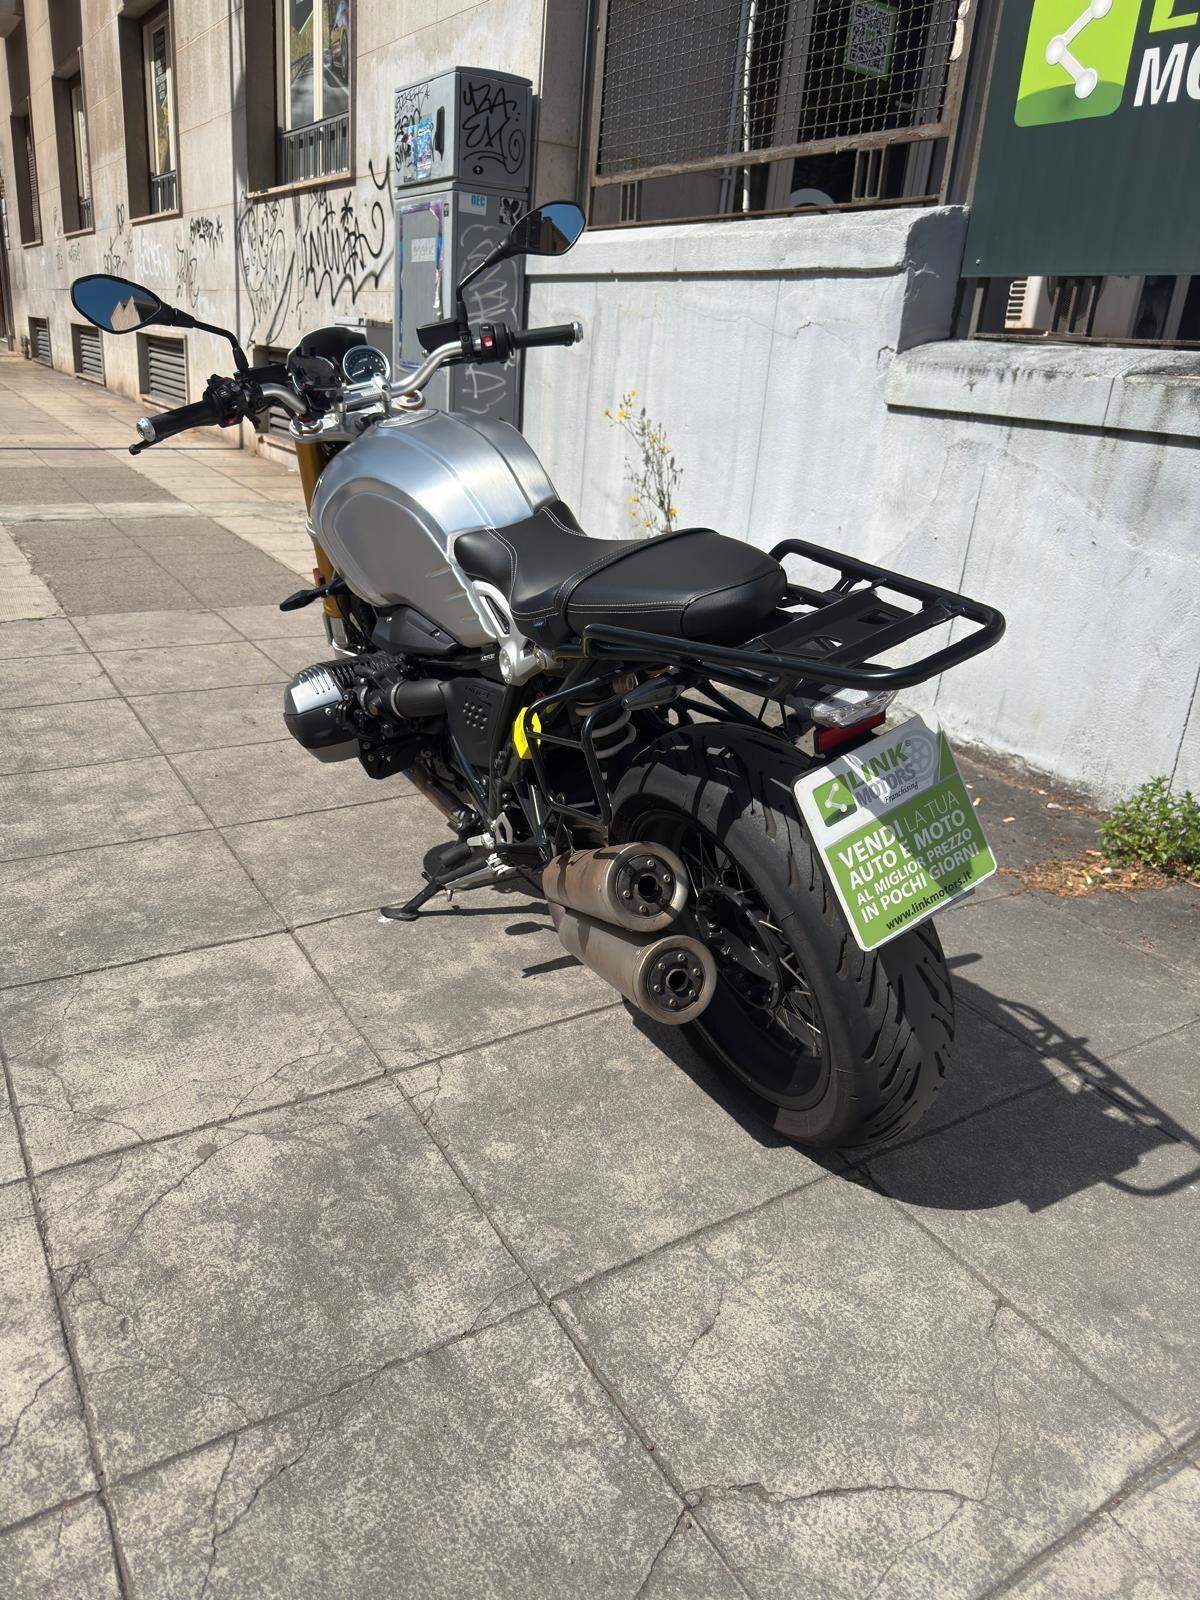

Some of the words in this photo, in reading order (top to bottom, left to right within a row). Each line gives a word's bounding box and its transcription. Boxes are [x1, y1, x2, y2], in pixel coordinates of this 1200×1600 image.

[845, 742, 909, 789] LINK
[854, 762, 916, 807] MOTORS
[884, 781, 919, 805] Franchising
[838, 819, 904, 869] VENDI
[904, 810, 927, 833] LA
[924, 791, 960, 819] TUA
[850, 850, 897, 890] AUTO
[899, 840, 913, 860] E
[913, 809, 965, 851] MOTO
[856, 892, 874, 906] AL
[874, 857, 926, 895] MIGLIOR
[926, 828, 972, 863] PREZZO
[860, 902, 880, 923] IN
[879, 872, 928, 911] POCHI
[929, 842, 980, 880] GIORNI
[886, 870, 973, 930] www.linkmotors.it
